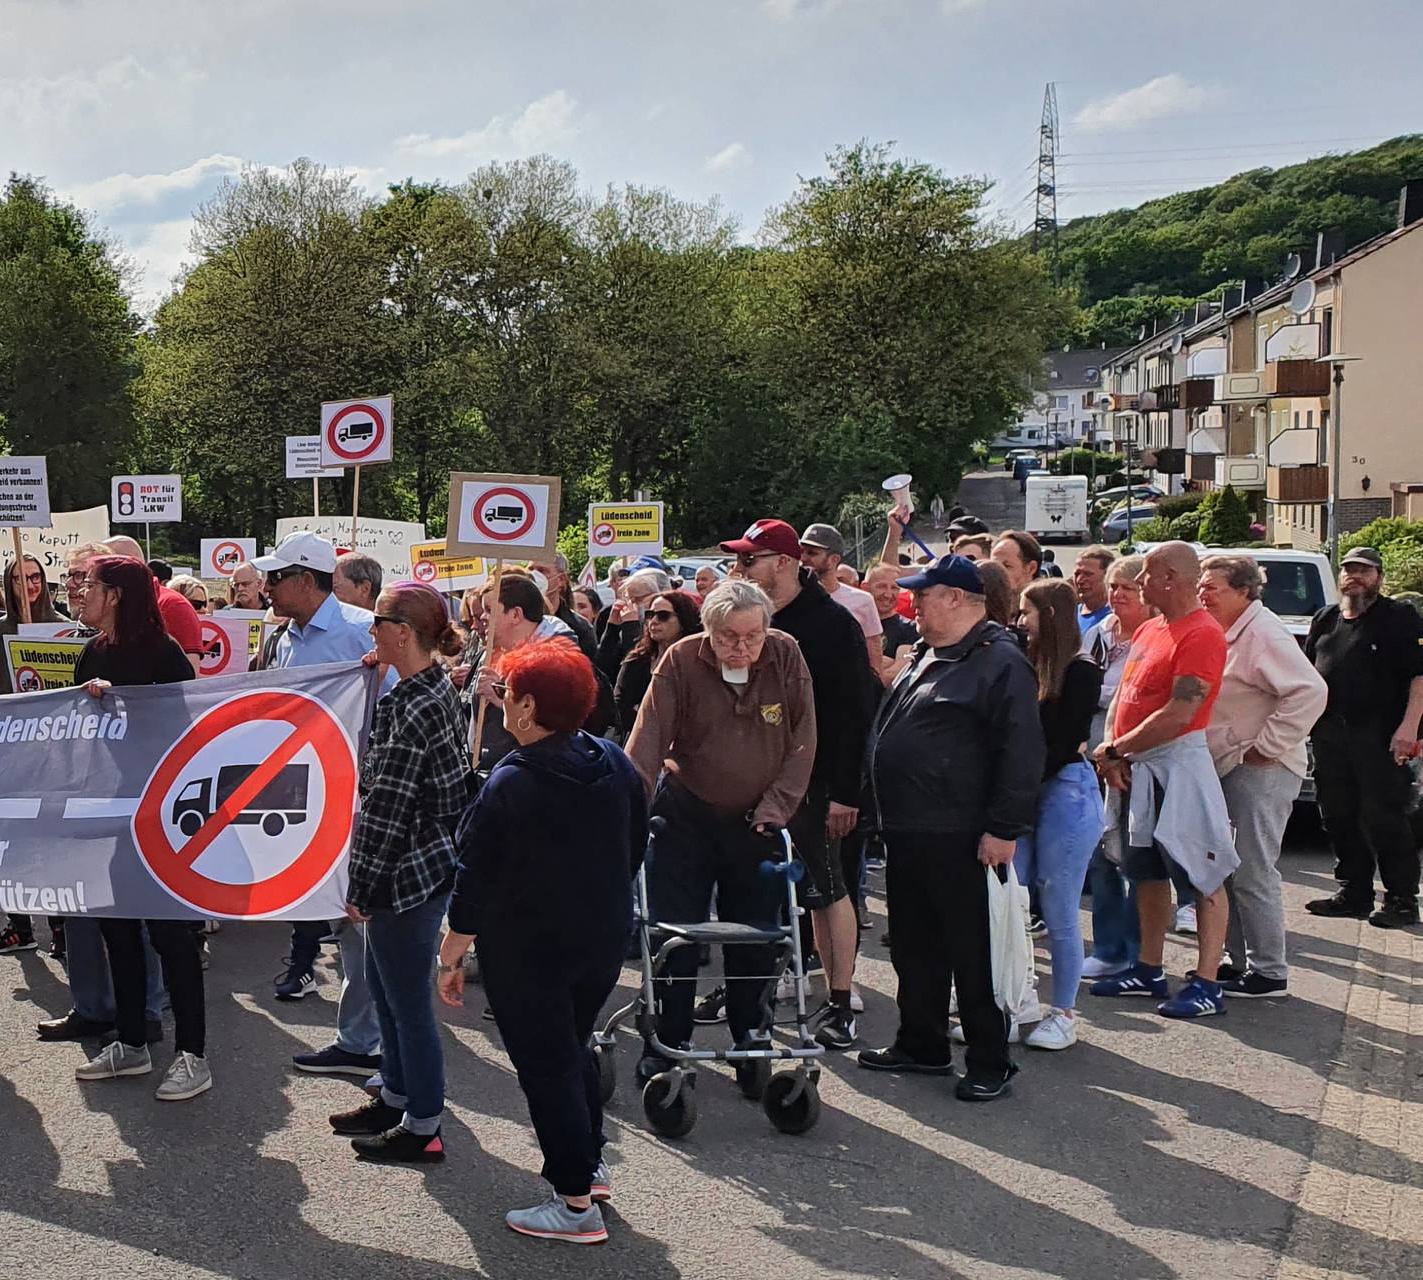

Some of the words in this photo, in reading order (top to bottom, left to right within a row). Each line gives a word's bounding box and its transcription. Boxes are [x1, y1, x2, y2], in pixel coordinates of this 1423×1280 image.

[1351, 455, 1366, 465] 30
[10, 477, 43, 486] verbannen!
[140, 485, 160, 493] ROT
[162, 485, 175, 493] für
[24, 492, 34, 500] der
[140, 495, 174, 503] Transit
[601, 510, 653, 520] Lüdenscheid
[634, 528, 650, 537] Zone
[20, 649, 79, 665] Lüdenschei
